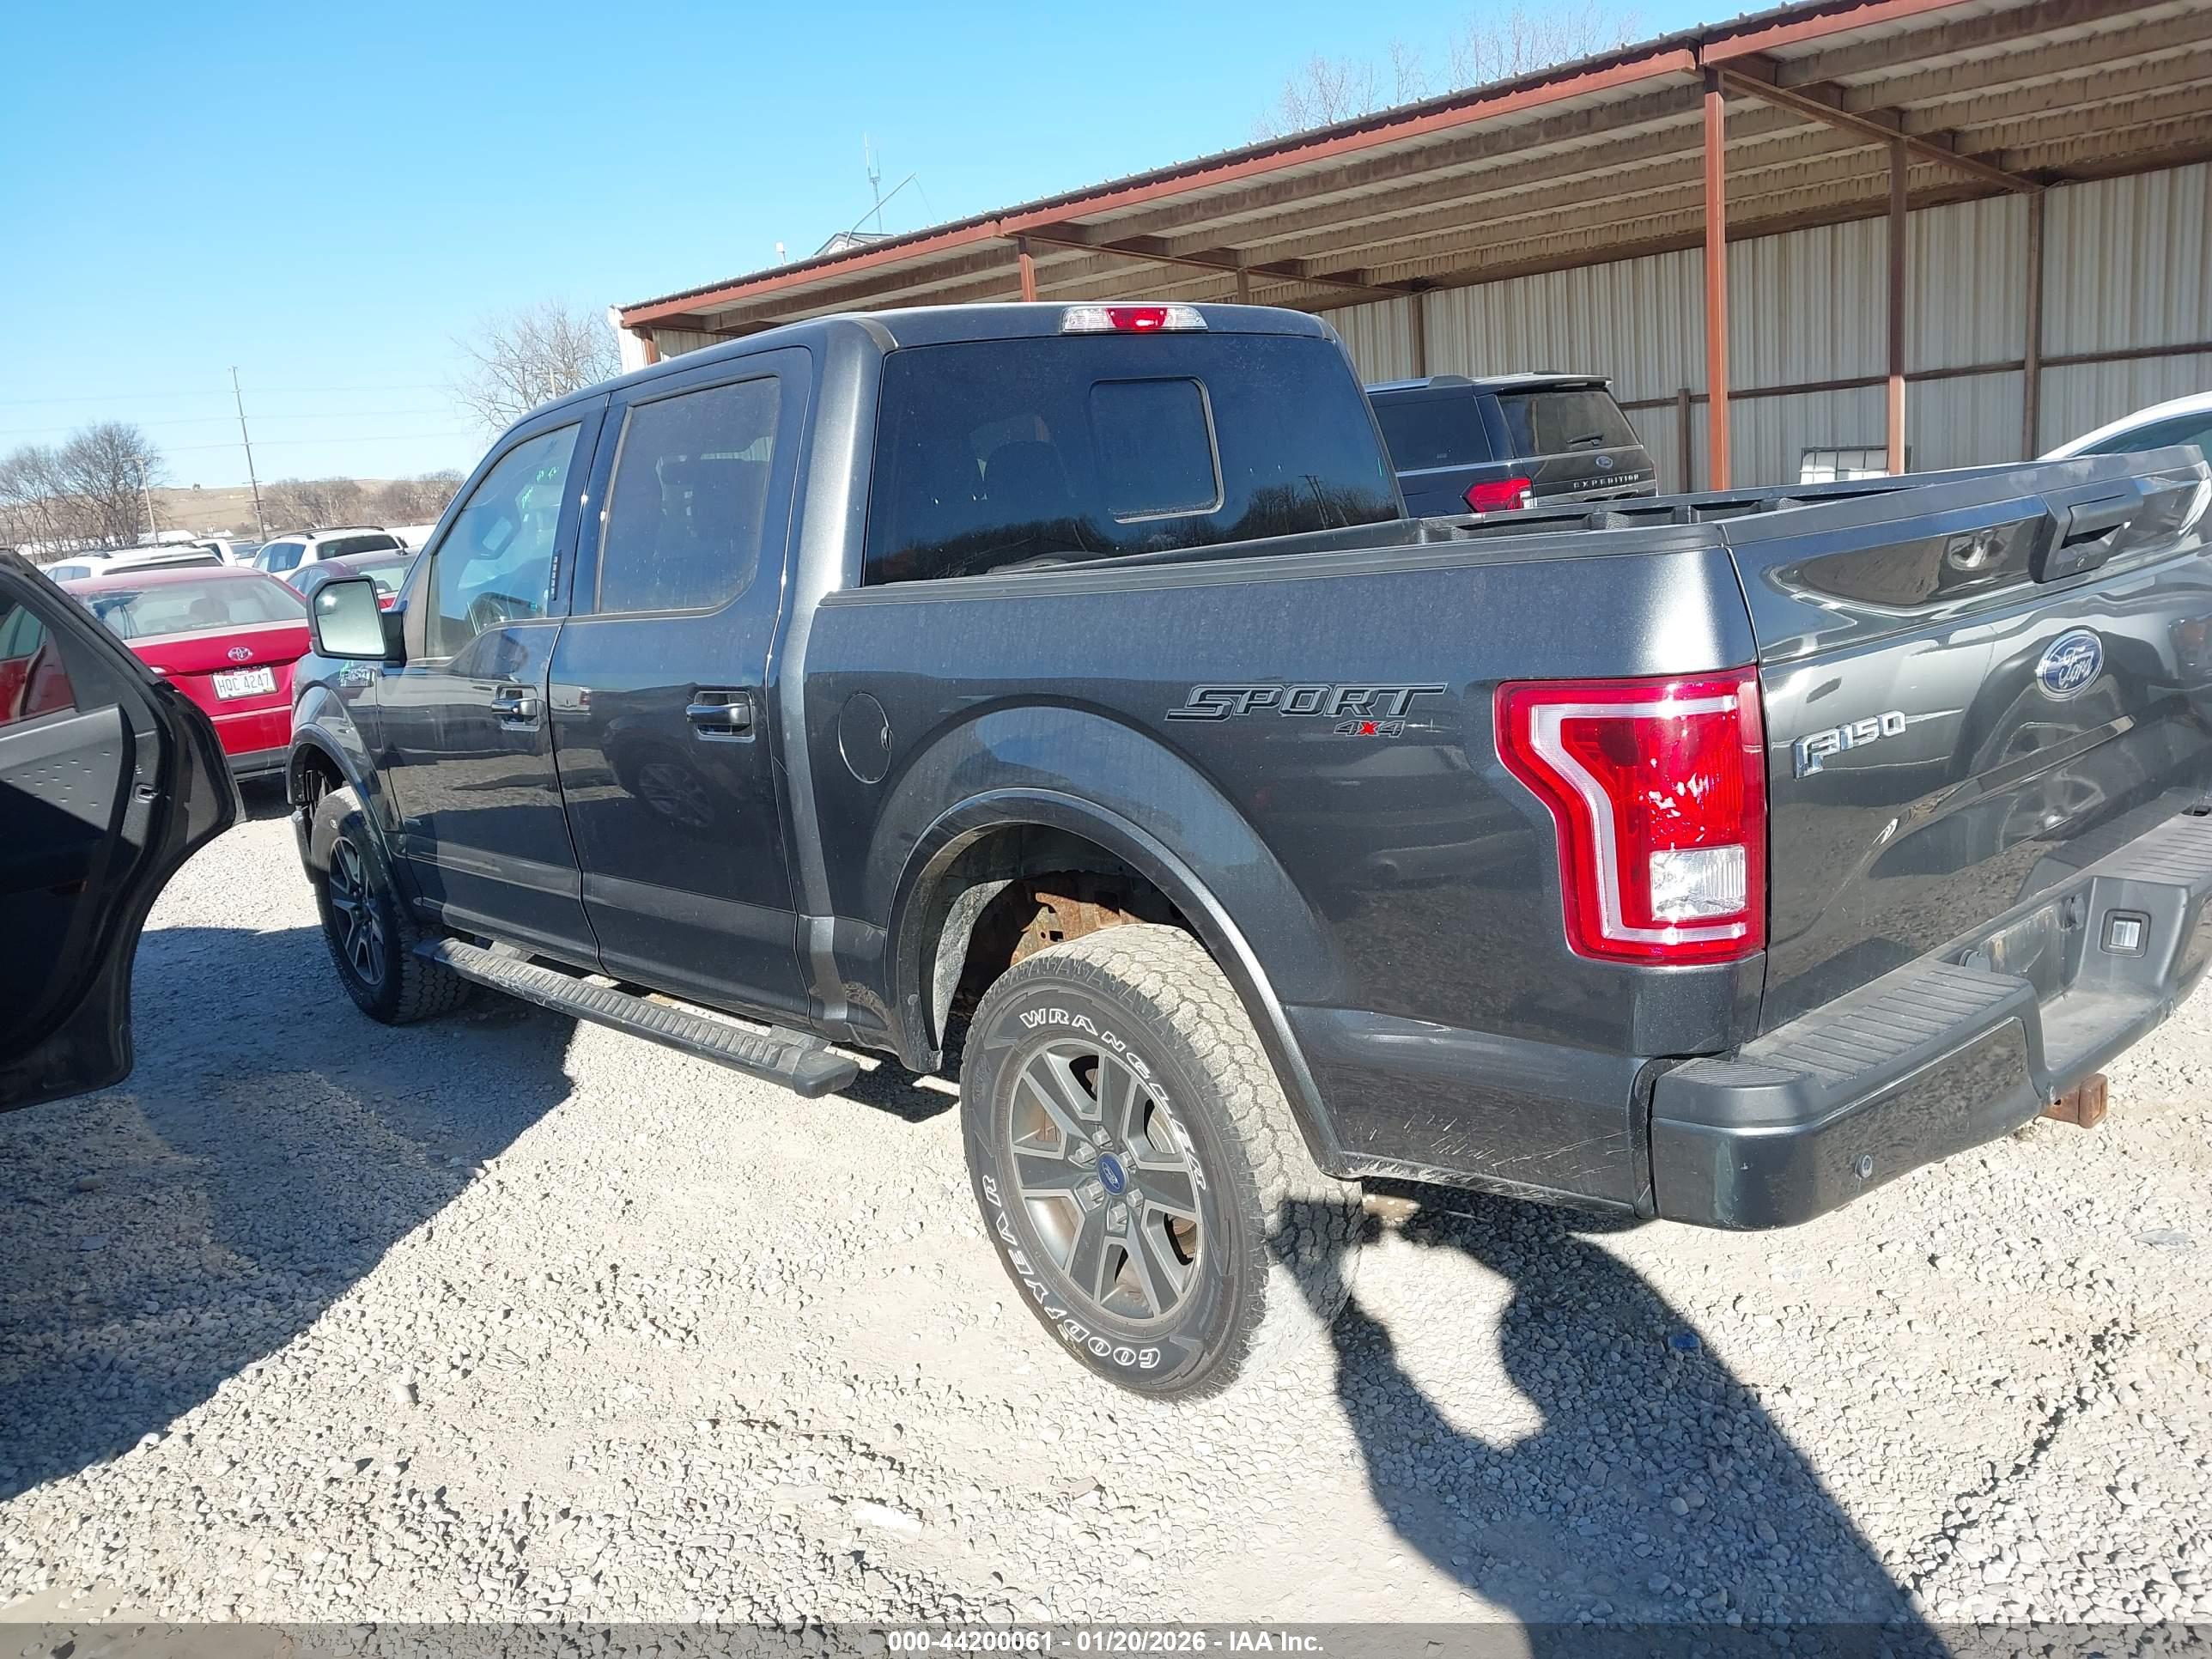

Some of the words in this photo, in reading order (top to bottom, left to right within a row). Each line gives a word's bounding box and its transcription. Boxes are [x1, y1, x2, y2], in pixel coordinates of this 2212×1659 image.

[1573, 474, 1639, 489] EXPEDITION
[244, 672, 270, 689] 4247
[1164, 683, 1449, 721] SPORT
[1019, 1008, 1206, 1191] WRANGLER
[982, 1175, 1161, 1369] GOODYEAR
